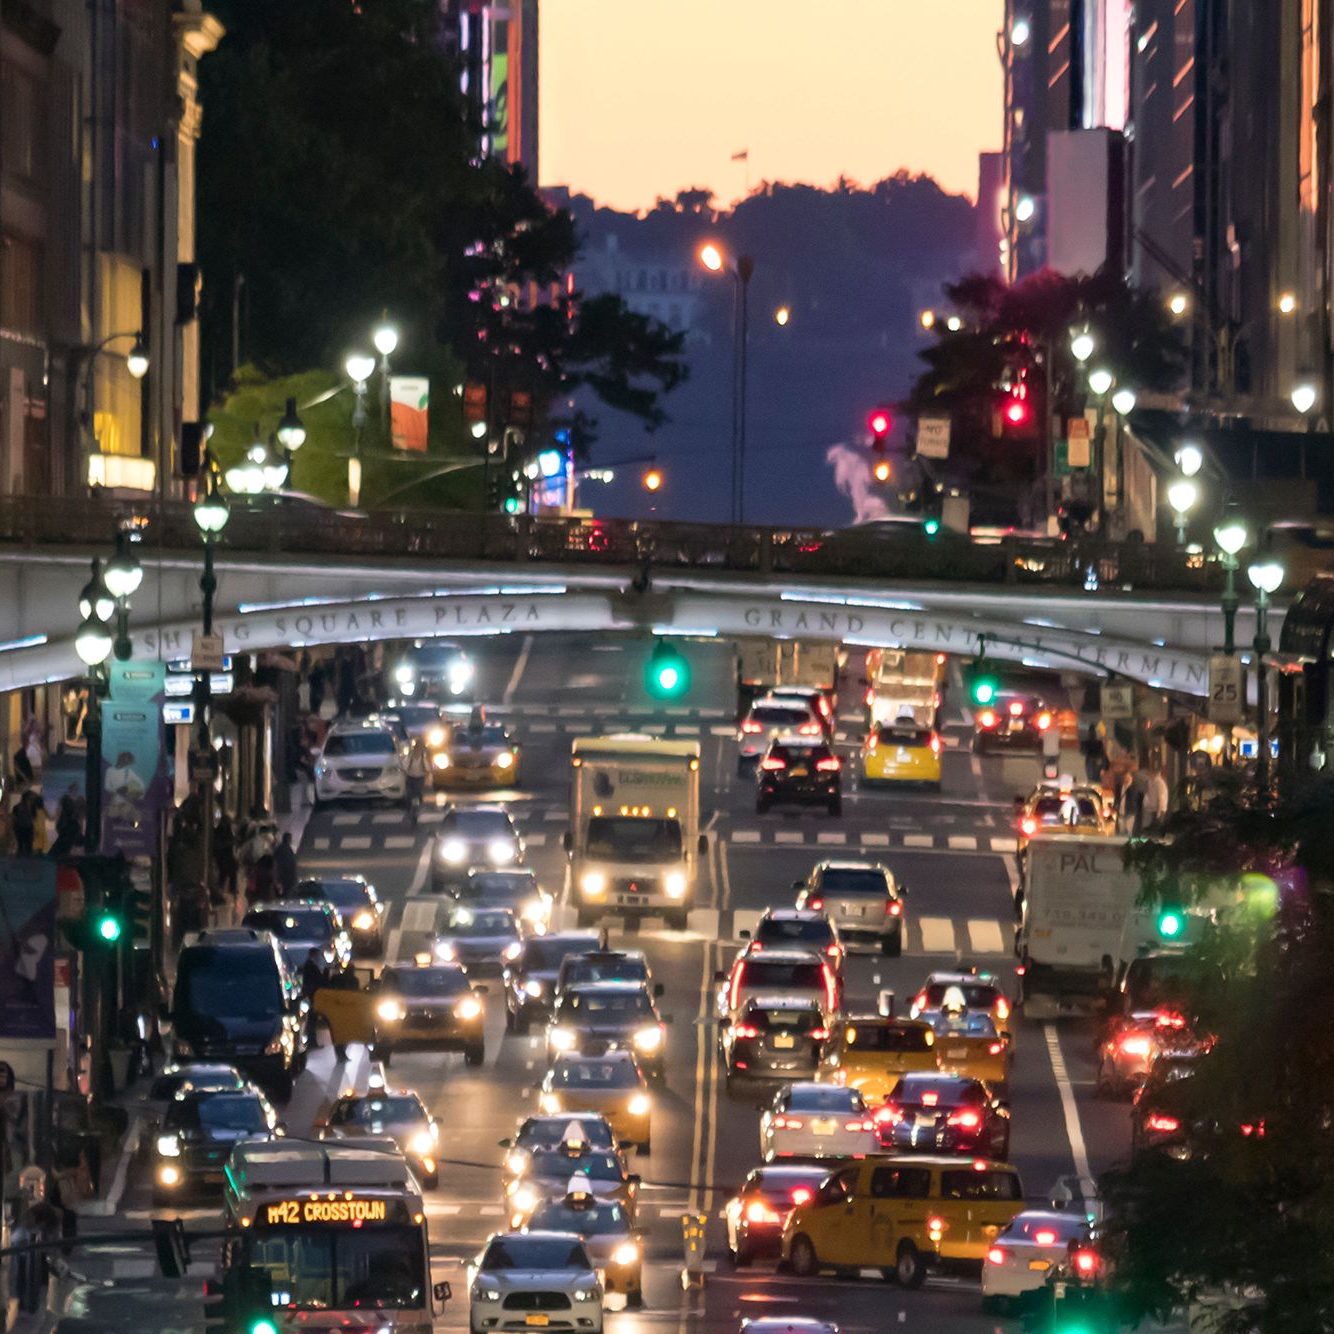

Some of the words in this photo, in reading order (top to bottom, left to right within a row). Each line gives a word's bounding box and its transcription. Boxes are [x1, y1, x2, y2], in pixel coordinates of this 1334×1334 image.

[276, 607, 407, 638] SQUARE
[435, 603, 539, 624] PLAZA
[745, 608, 864, 633] GRAND
[1073, 642, 1205, 684] TERMIN
[1213, 684, 1237, 701] 25
[304, 1200, 386, 1222] CROSSTOWN
